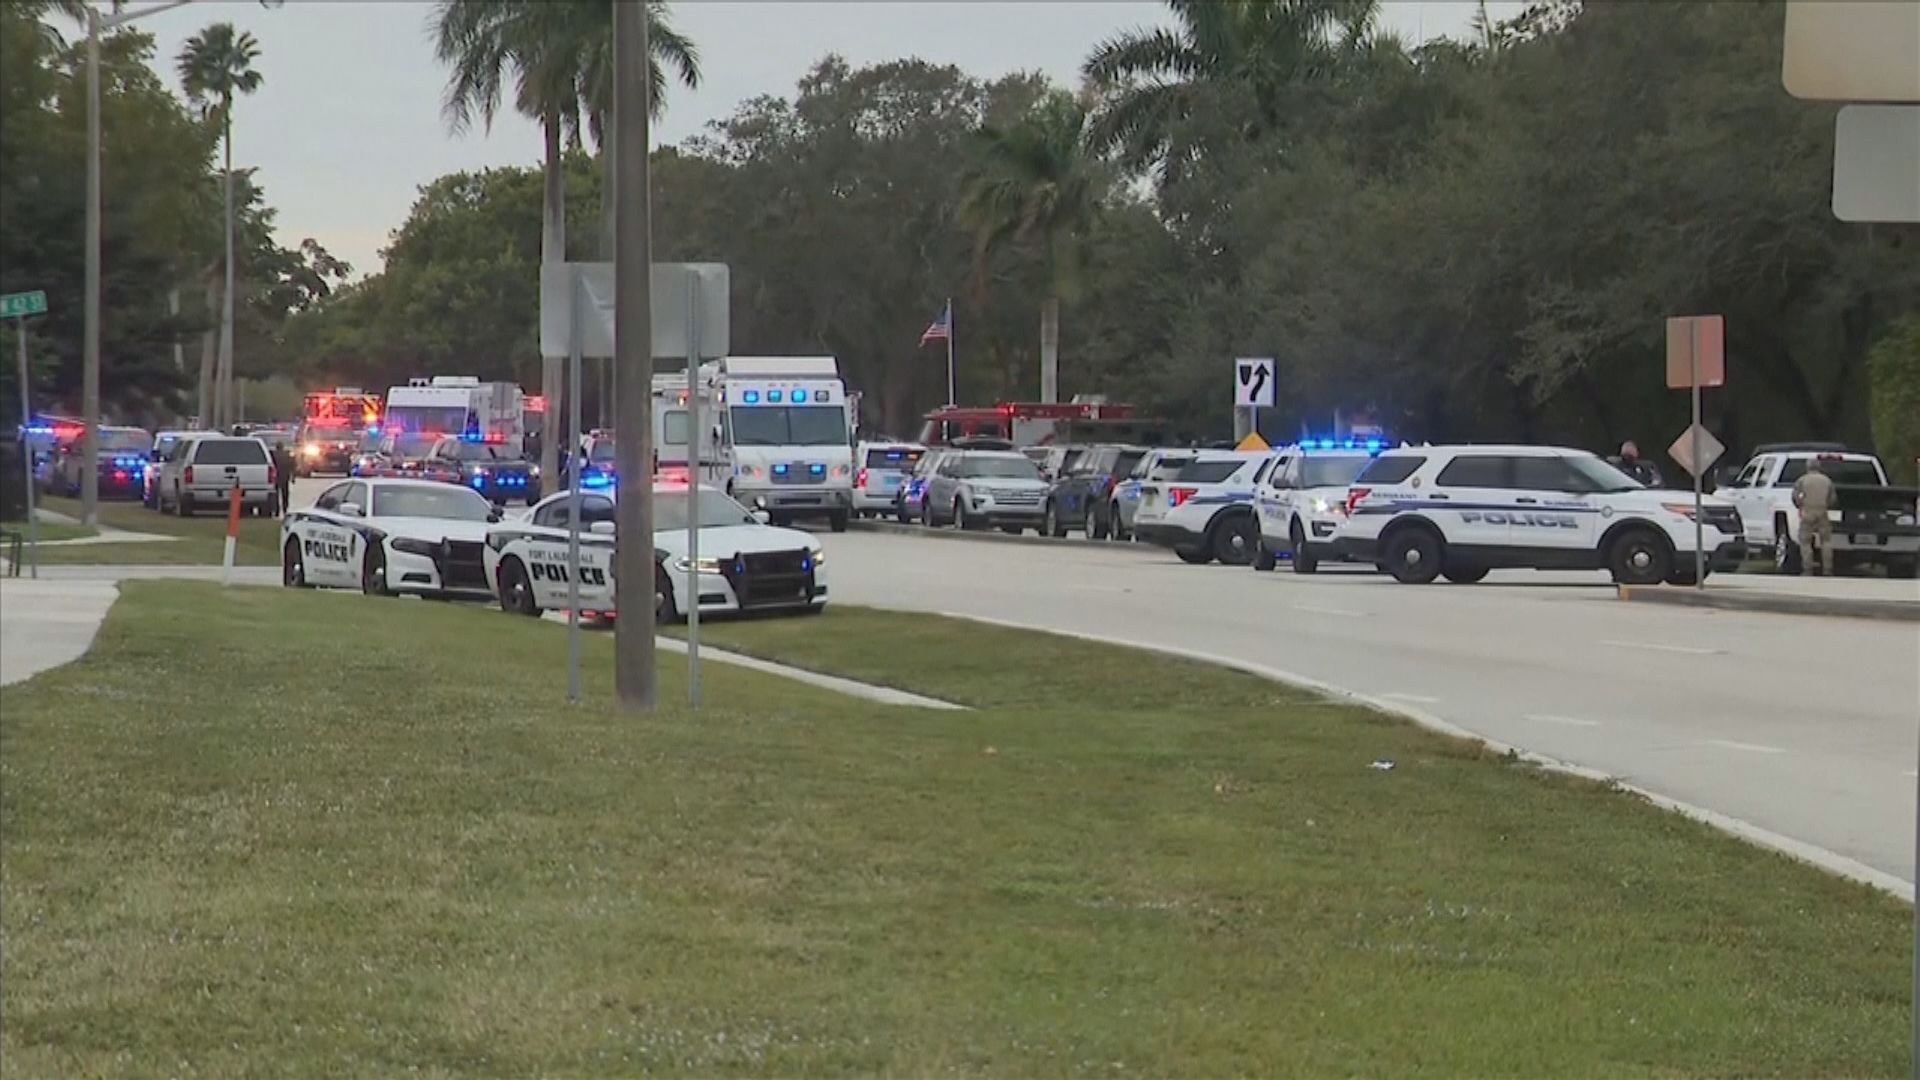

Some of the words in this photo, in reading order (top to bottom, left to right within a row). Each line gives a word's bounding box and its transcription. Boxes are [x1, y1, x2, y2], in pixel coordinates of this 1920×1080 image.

[1459, 512, 1579, 530] POLICE
[304, 539, 348, 563] POLICE
[530, 562, 606, 586] POLCE
